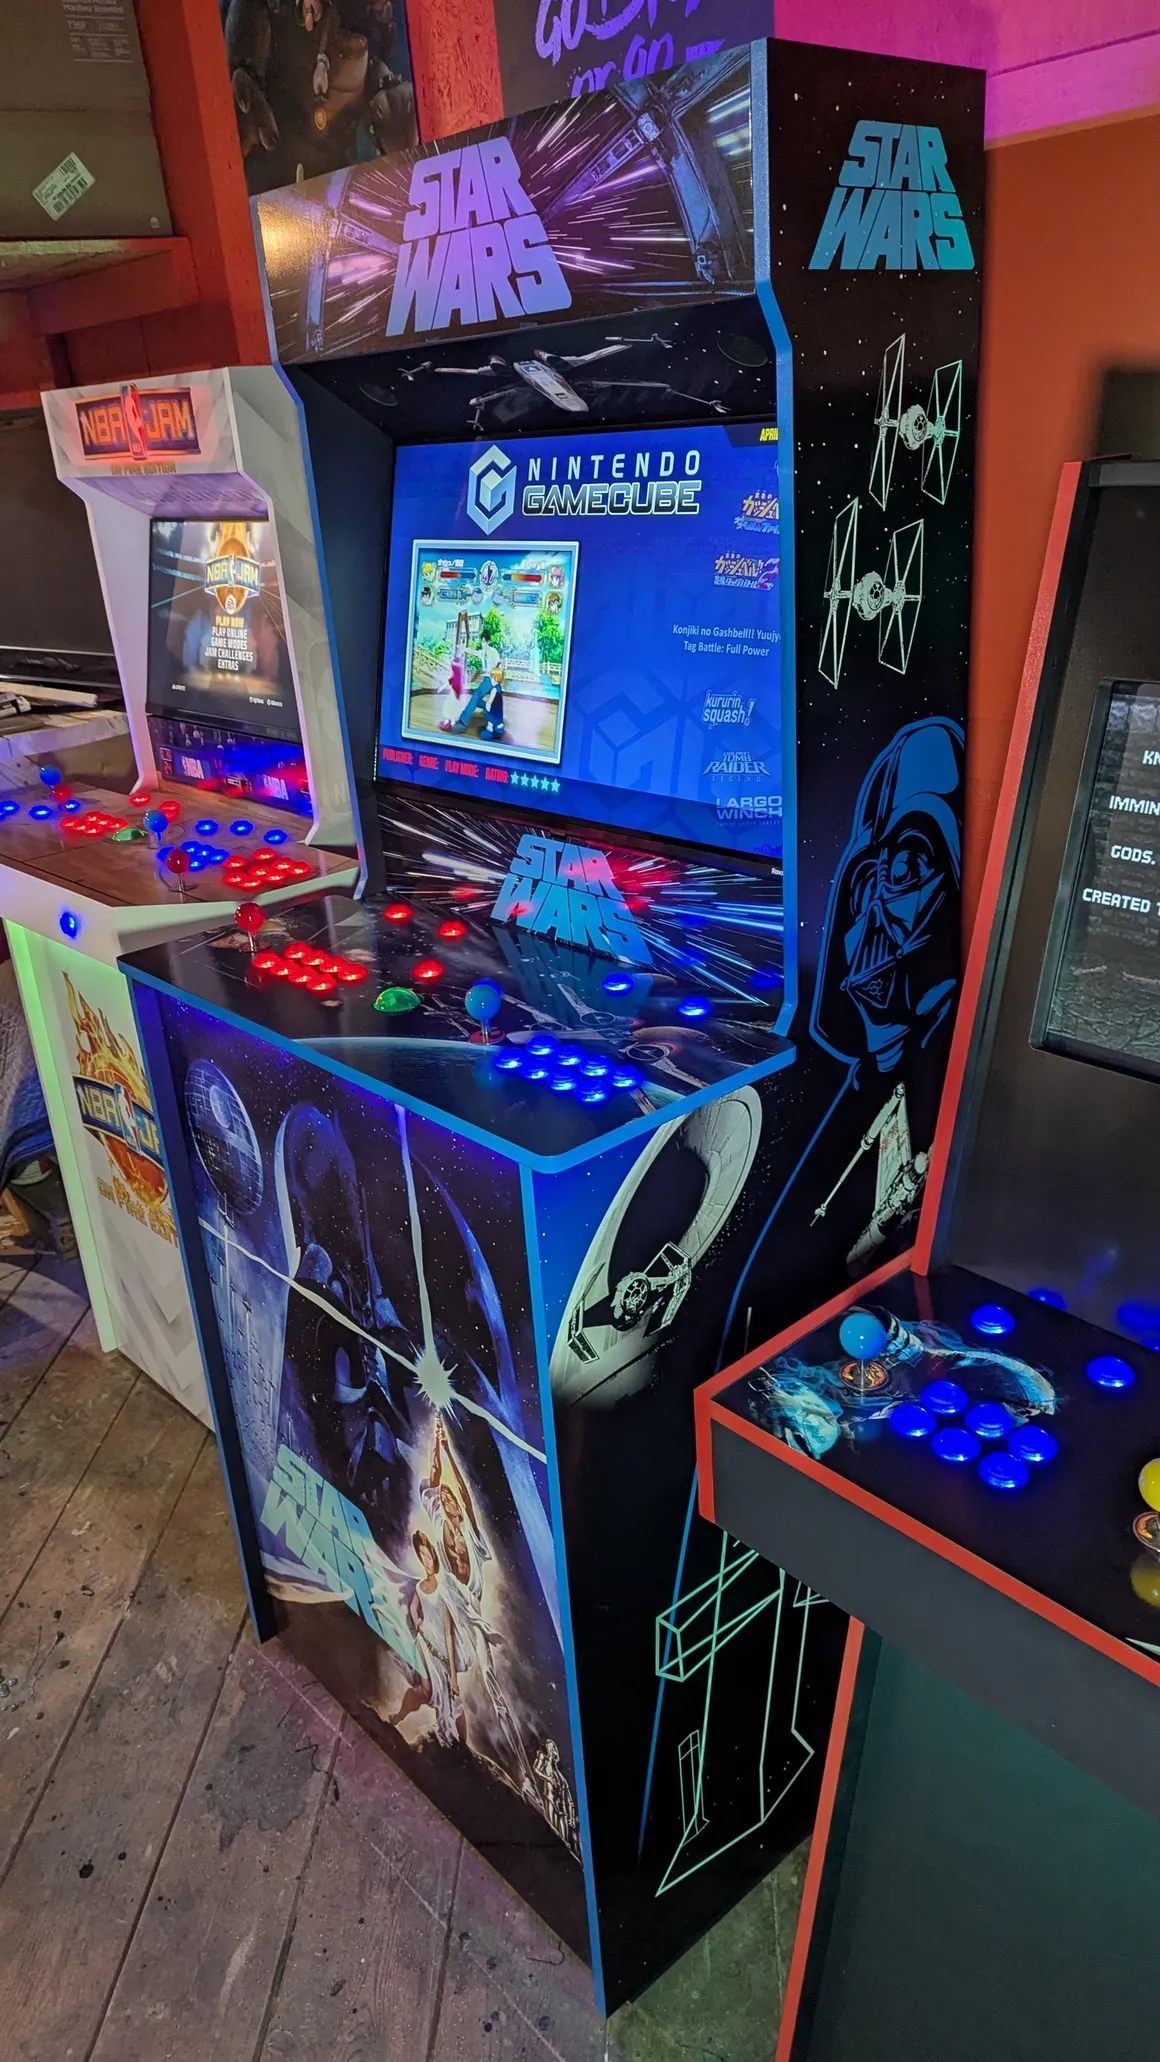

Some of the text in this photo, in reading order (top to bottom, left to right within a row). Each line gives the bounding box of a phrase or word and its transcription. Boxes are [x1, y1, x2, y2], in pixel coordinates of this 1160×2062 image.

[839, 120, 956, 192] STAR
[403, 136, 538, 241] STAR
[808, 187, 975, 271] WARS
[385, 214, 573, 337] WARS
[80, 400, 196, 446] NBA JAM
[528, 450, 700, 481] NINTENDO
[522, 480, 702, 516] GAMECUBE
[207, 562, 228, 583] NBA
[237, 563, 259, 585] JAM
[212, 626, 247, 639] PLAY ONLINE
[216, 615, 230, 627] PLAY
[673, 624, 699, 637] Konjiki
[701, 628, 711, 636] no
[713, 626, 754, 639] Gashbell!!
[205, 647, 253, 662] JAM CHALLENGES
[211, 637, 247, 650] GAME MODES
[684, 641, 769, 657] Tag Battle: Full Power
[218, 659, 238, 670] EXTRAS
[706, 692, 741, 708] kururin
[703, 699, 755, 727] squash!
[185, 757, 204, 779] NBA
[444, 759, 460, 773] PLAY
[703, 761, 771, 776] RAIDER
[716, 796, 783, 808] LARGO
[716, 807, 783, 819] WINCH
[1110, 844, 1156, 865] GODS.
[509, 834, 625, 902] STAR
[1082, 888, 1151, 913] CREATED
[490, 873, 654, 966] WARS
[77, 1085, 121, 1128] NBA
[272, 1443, 402, 1590] STAR
[260, 1479, 428, 1680] WARS
